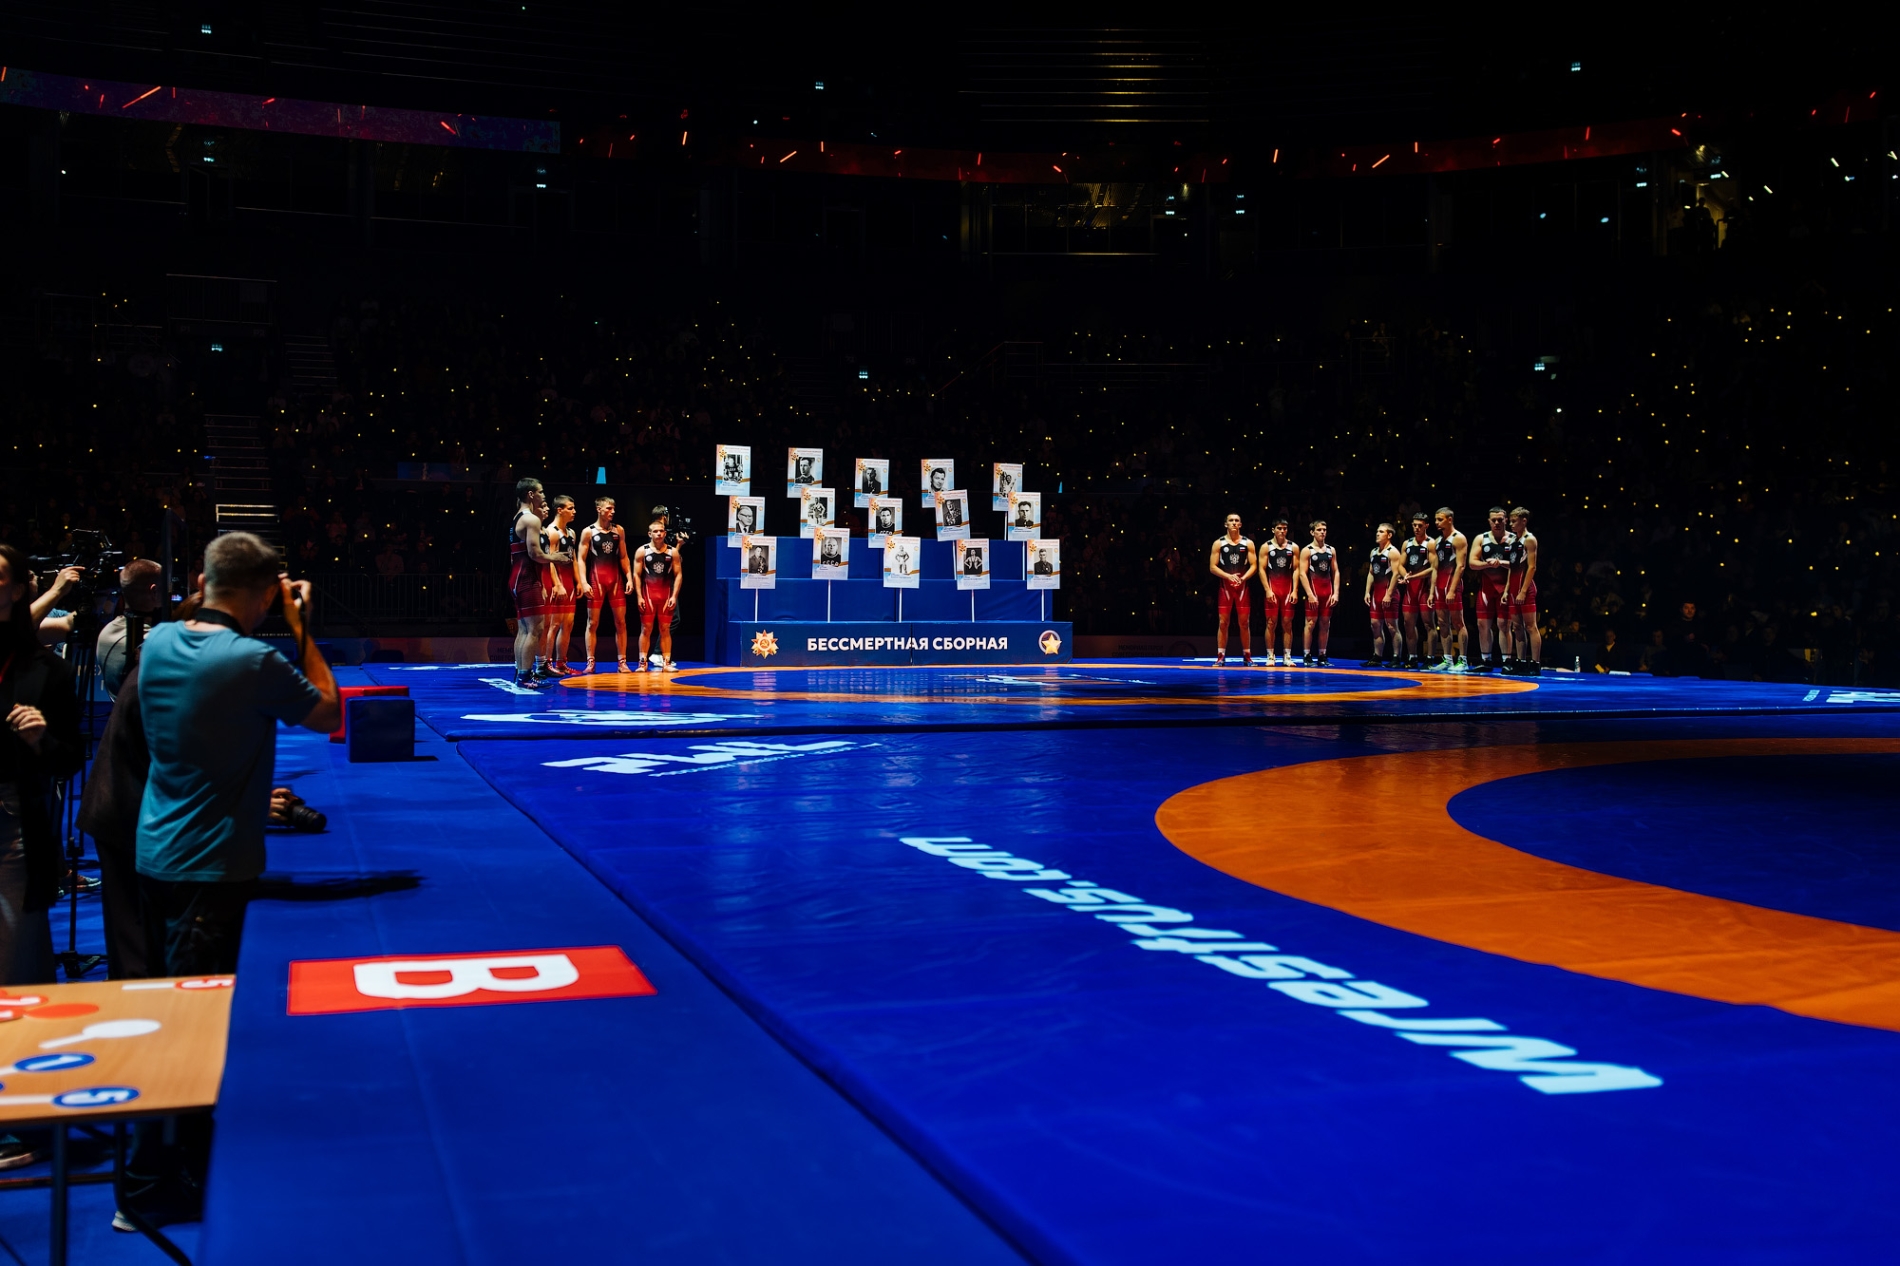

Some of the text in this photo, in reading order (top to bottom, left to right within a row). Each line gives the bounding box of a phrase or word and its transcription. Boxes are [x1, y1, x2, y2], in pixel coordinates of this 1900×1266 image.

[807, 637, 1008, 652] БЕССМЕРТНАЯ СБОРНАЯ
[900, 835, 1664, 1095] wrestrus.com
[61, 1090, 129, 1105] 5
